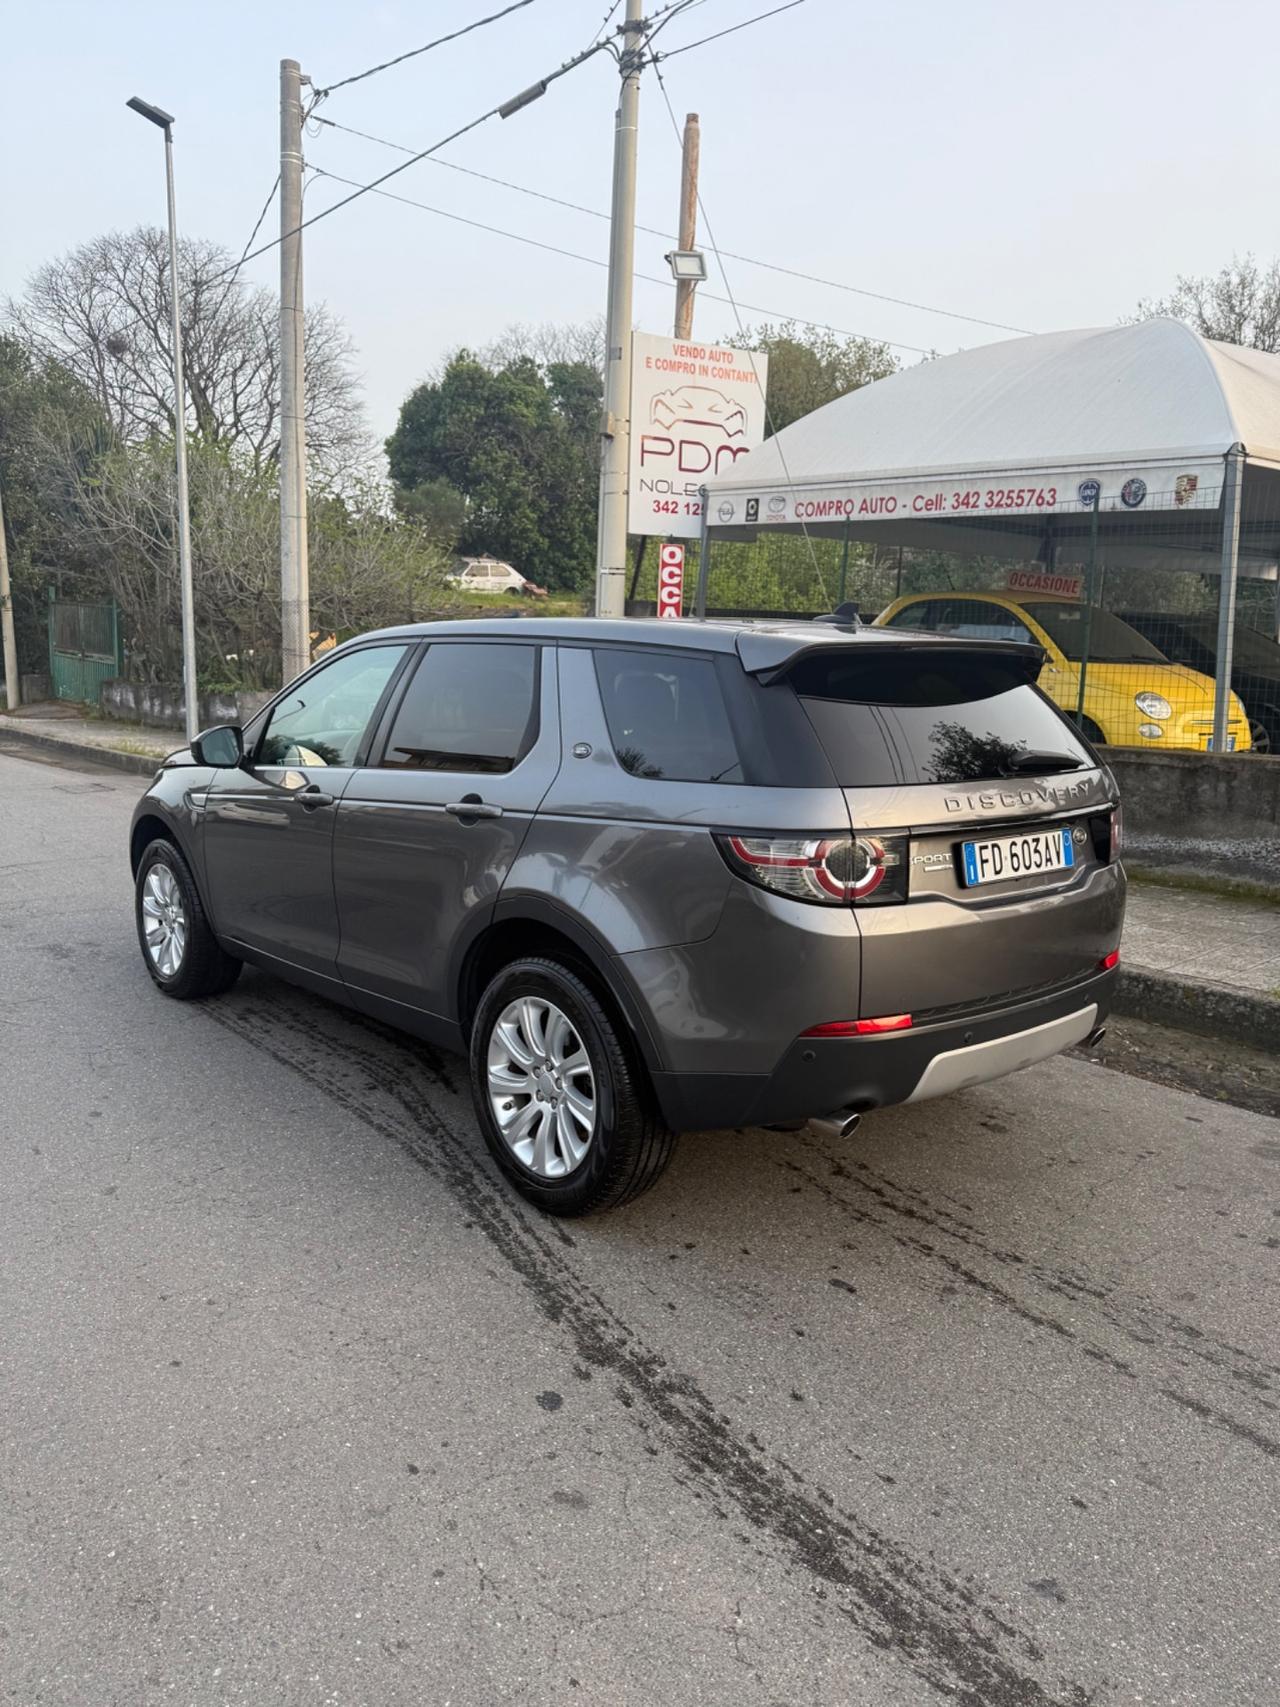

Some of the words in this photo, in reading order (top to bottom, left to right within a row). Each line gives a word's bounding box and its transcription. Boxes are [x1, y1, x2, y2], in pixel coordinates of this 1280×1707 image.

[673, 344, 706, 360] VENDO
[709, 350, 734, 364] AUTO
[645, 357, 653, 369] E
[655, 359, 696, 375] COMPRO
[699, 364, 709, 377] IN
[652, 500, 679, 514] 342
[794, 498, 855, 518] COMPRO
[858, 496, 897, 514] AUTO
[912, 493, 947, 512] Cell:
[951, 491, 981, 510] 342
[985, 488, 1057, 508] 3255763
[1009, 572, 1079, 594] OCCASIONE
[944, 783, 1090, 813] DISCOVERY
[978, 843, 1003, 878] FD
[1009, 833, 1061, 873] 603AV
